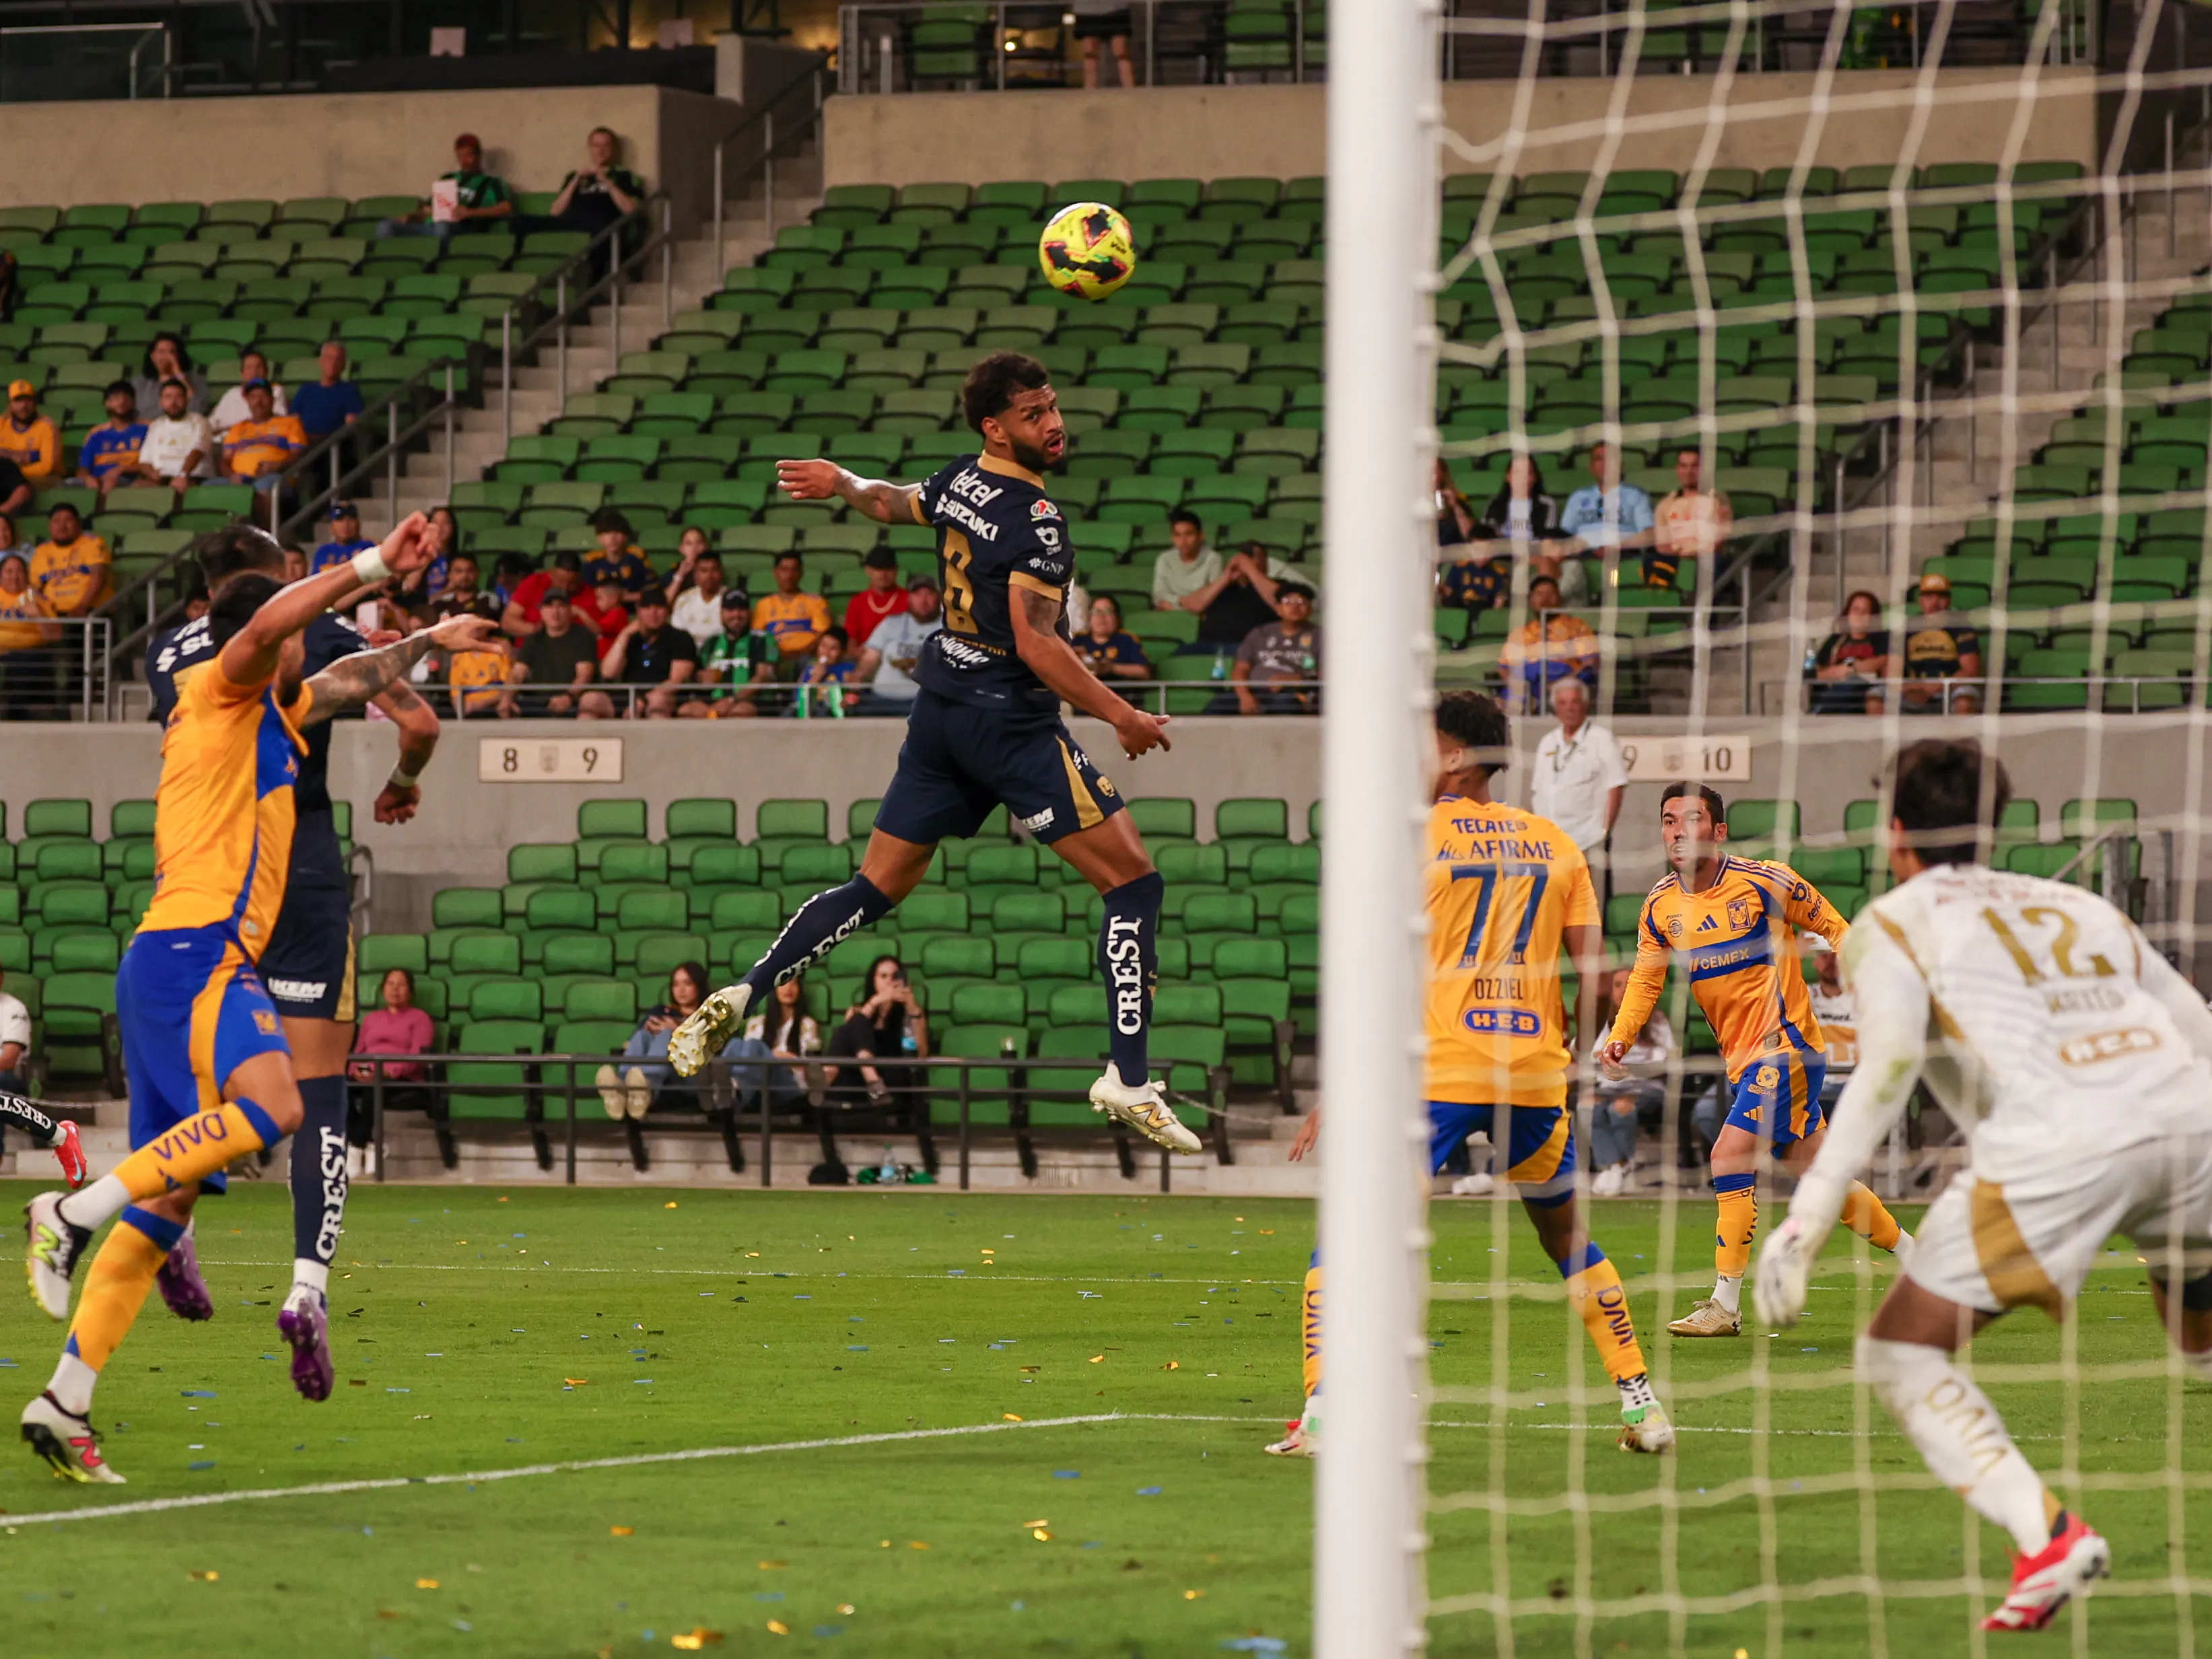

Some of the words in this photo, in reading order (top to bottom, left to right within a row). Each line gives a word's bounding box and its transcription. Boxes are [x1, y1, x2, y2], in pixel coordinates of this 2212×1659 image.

[949, 468, 1004, 507] telcel
[504, 747, 518, 772] 8
[582, 747, 597, 773] 9
[1622, 745, 1637, 772] 9
[1702, 744, 1732, 772] 10
[1451, 818, 1515, 834] TECATE
[1470, 841, 1554, 860] AFIRME
[1451, 863, 1548, 968] 77
[1700, 948, 1750, 970] CEMEX
[1982, 906, 2118, 987] 12
[1106, 915, 1142, 1035] CREST
[1474, 978, 1523, 1001] OZZIEL
[0, 1094, 52, 1130] CREST
[316, 1125, 347, 1260] CREST
